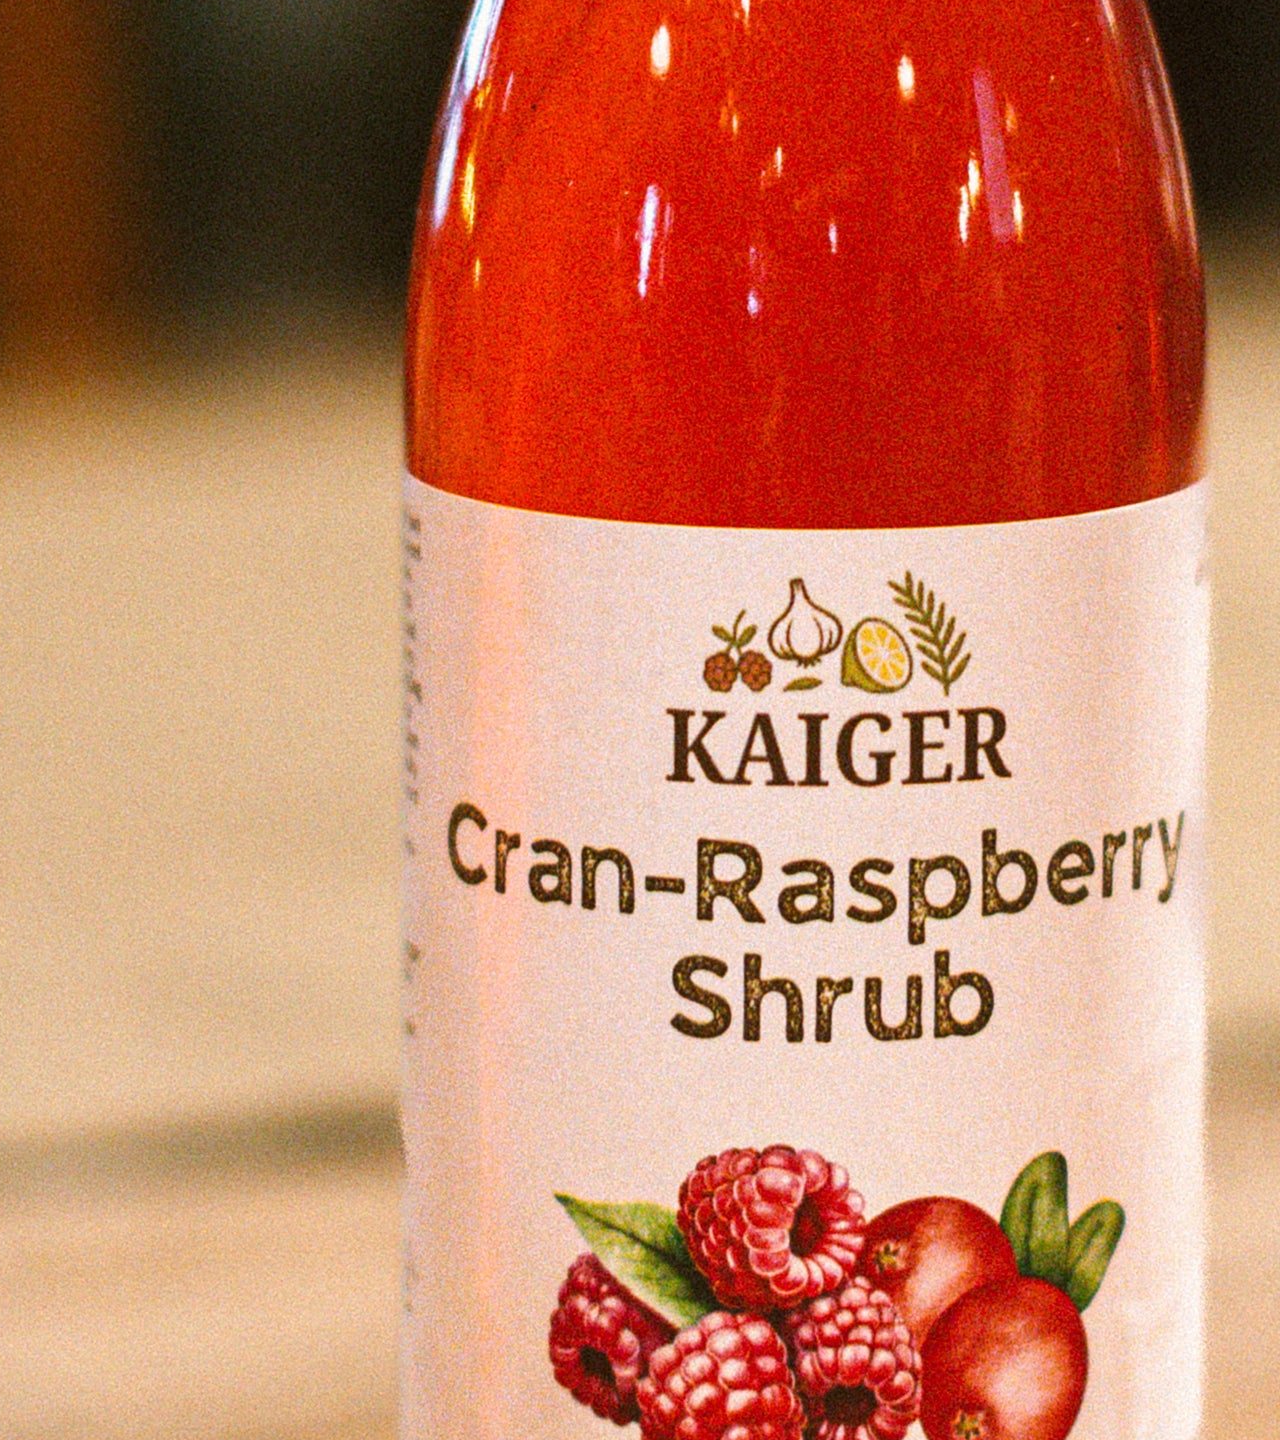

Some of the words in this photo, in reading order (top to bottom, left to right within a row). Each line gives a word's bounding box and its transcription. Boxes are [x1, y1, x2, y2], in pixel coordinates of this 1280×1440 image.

[665, 706, 1012, 787] KAIGER
[447, 802, 1185, 946] Cran-Raspberry
[670, 951, 995, 1043] Shrub
